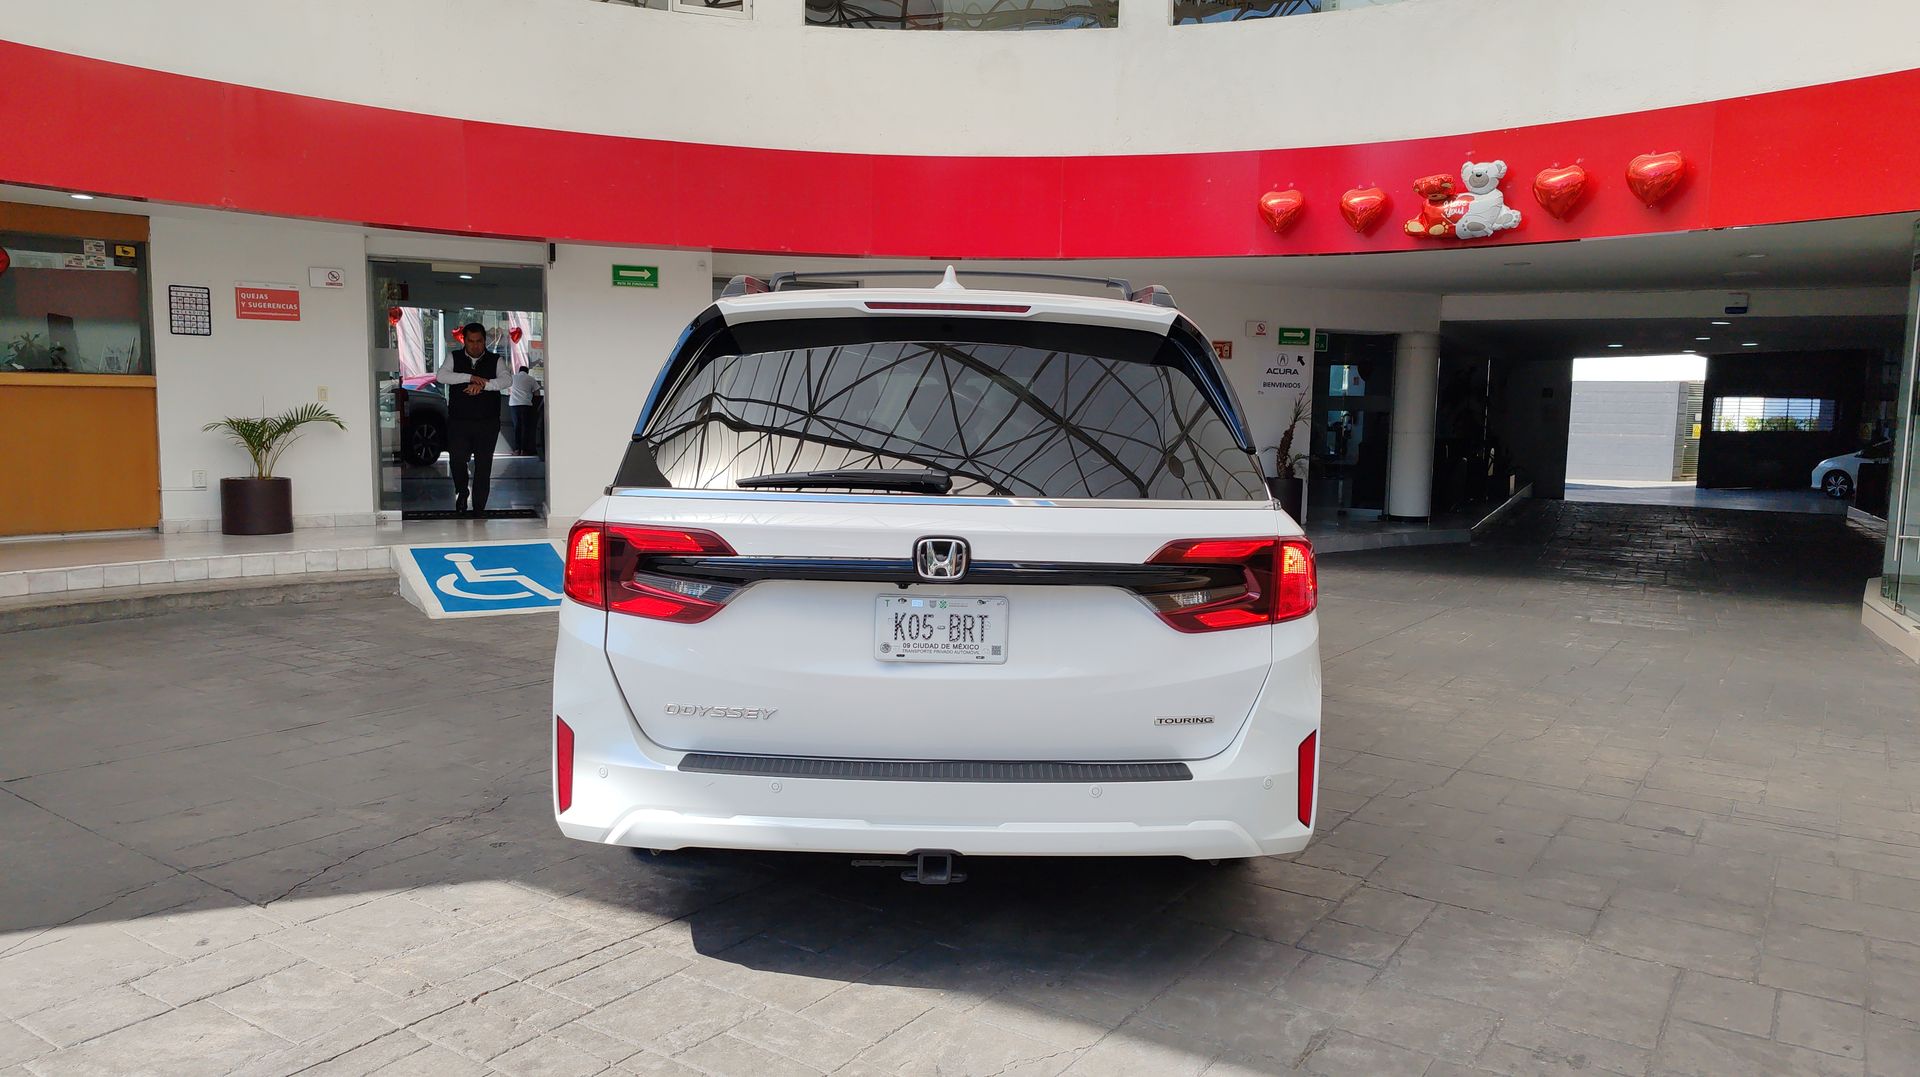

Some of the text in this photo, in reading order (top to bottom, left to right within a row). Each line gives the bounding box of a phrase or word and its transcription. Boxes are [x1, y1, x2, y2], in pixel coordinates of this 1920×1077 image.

[240, 292, 268, 300] QUEJAS
[248, 302, 298, 310] SUGERENCIAS
[894, 612, 989, 643] K05-BRT
[664, 703, 778, 720] ODYSSEY
